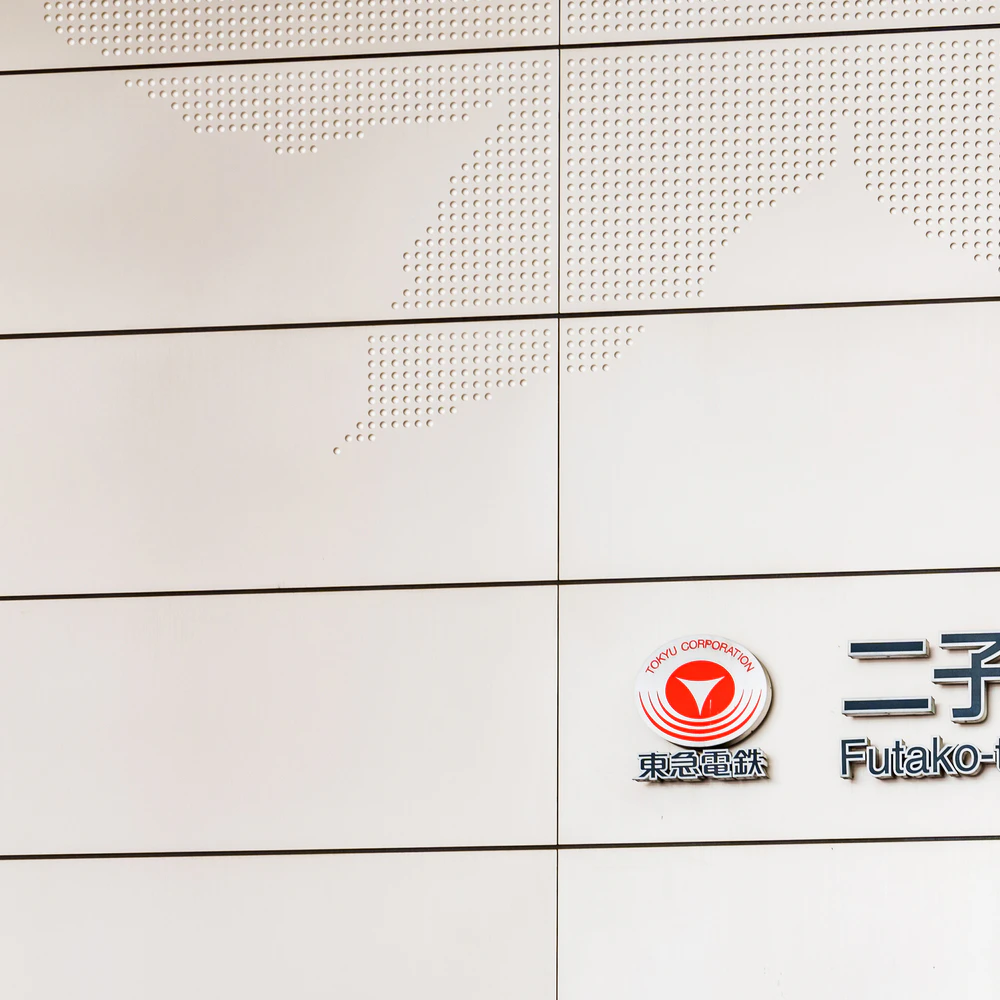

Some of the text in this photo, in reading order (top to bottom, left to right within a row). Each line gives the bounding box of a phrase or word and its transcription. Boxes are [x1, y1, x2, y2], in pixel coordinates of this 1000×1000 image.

[645, 639, 755, 675] TOKYU CORPORATION
[638, 749, 766, 778] 東急電鉄
